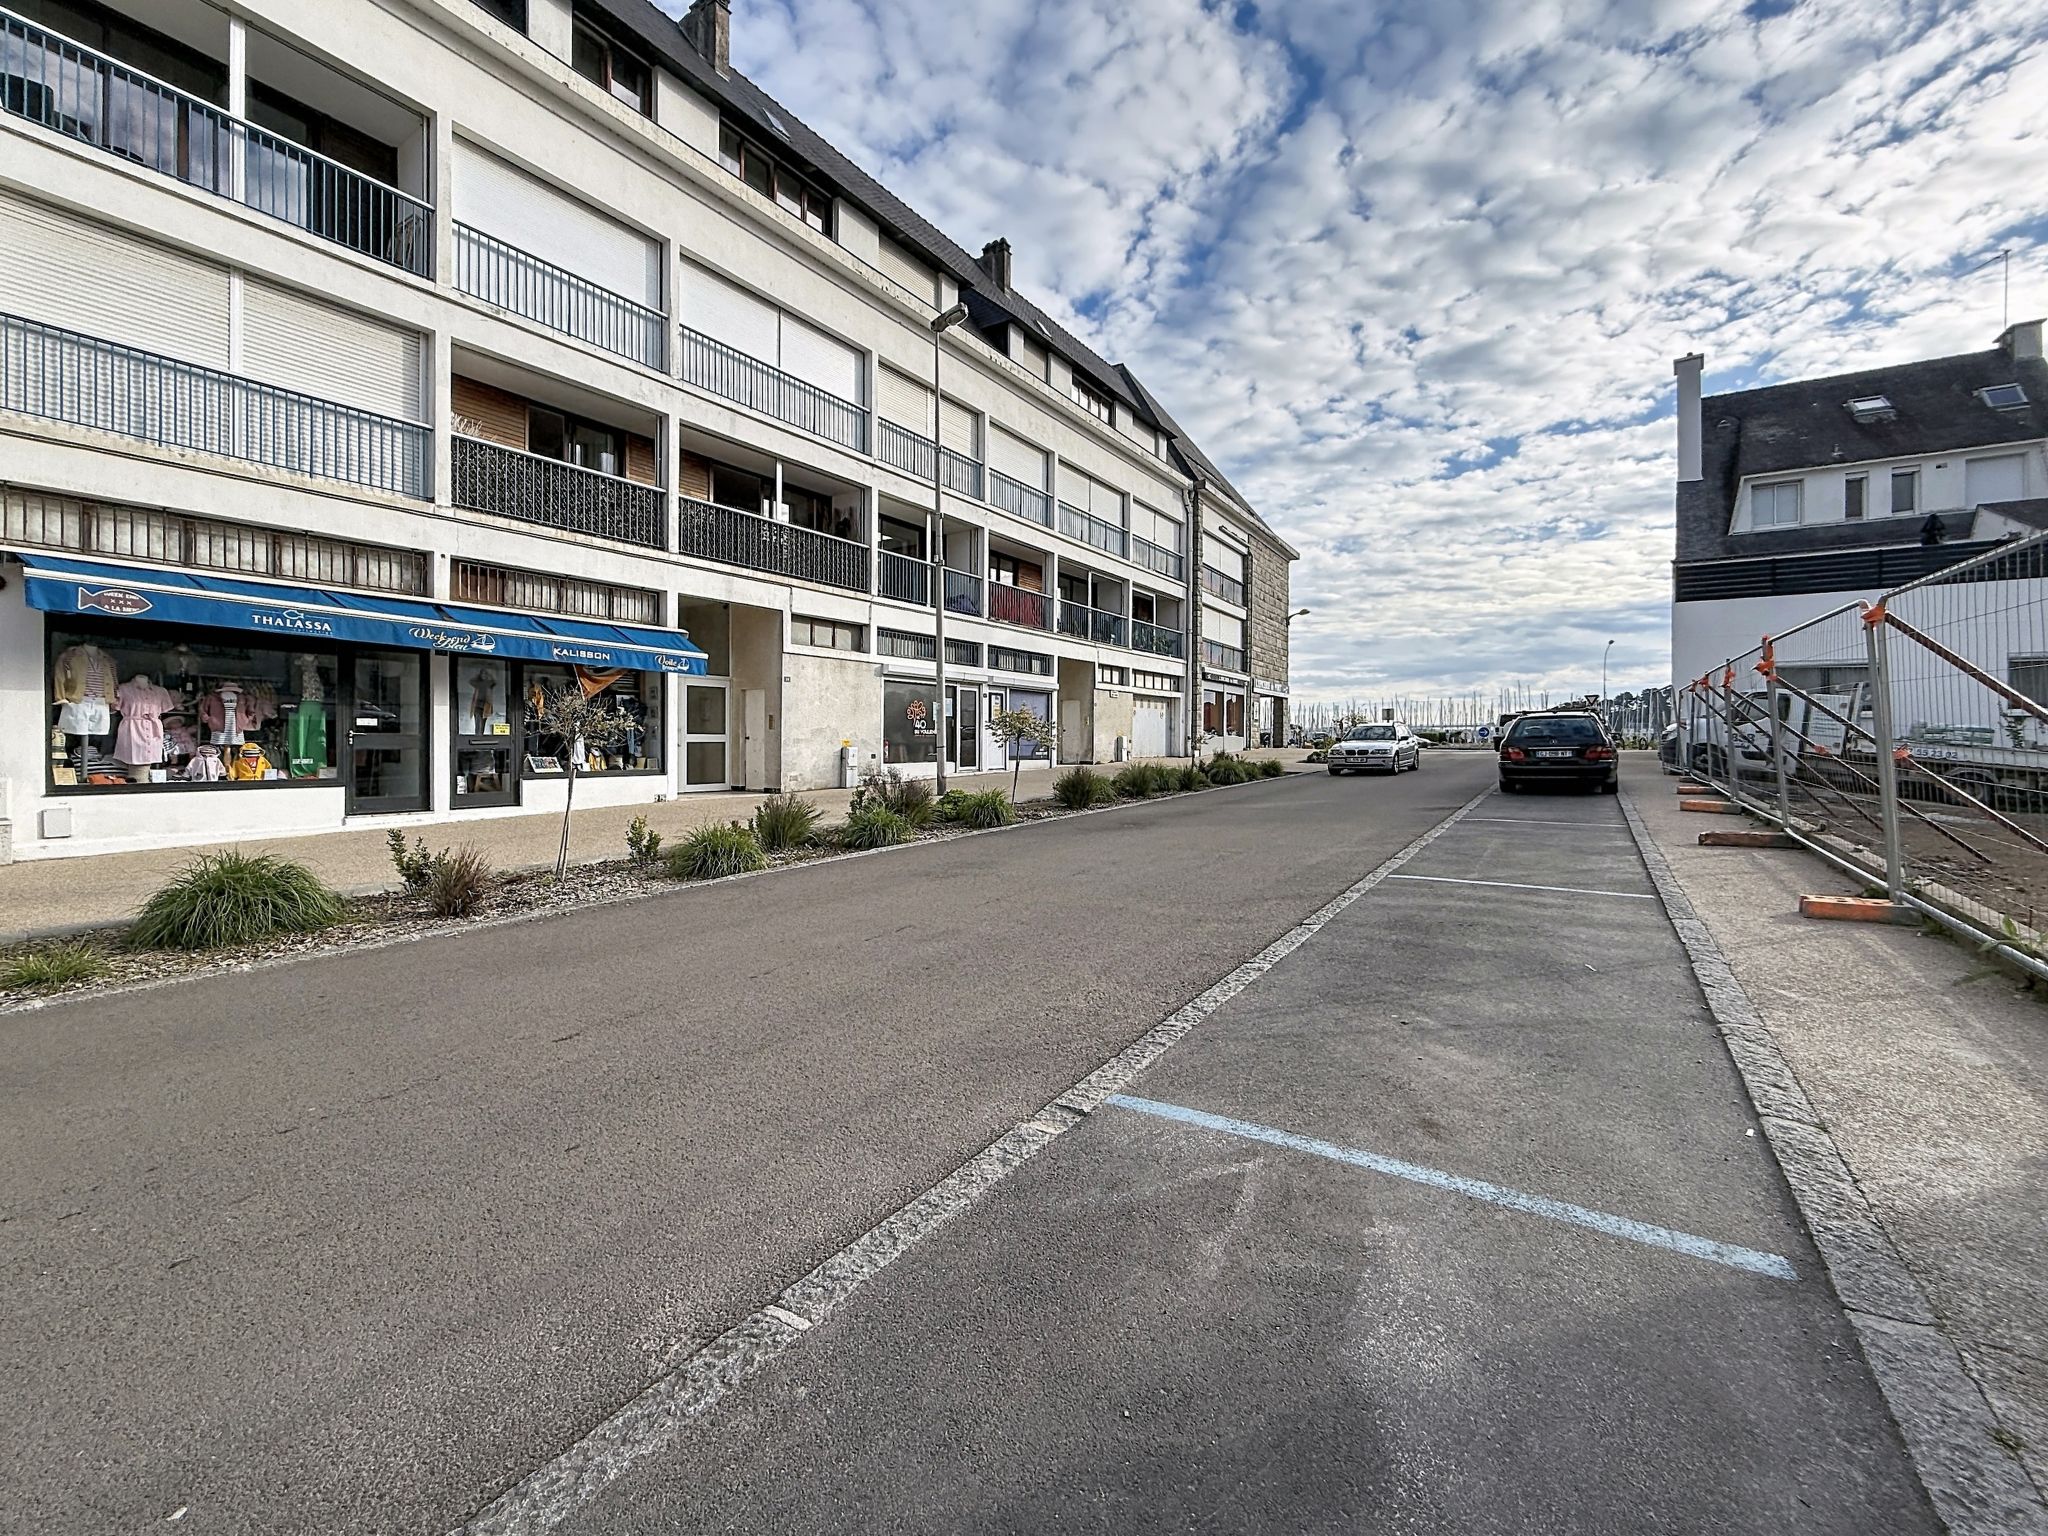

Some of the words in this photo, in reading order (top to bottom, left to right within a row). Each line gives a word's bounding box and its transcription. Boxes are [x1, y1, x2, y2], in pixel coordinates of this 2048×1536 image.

[251, 614, 332, 631] THALASSA
[553, 647, 610, 660] KALISSON
[654, 655, 677, 667] Voile
[914, 719, 927, 729] 40
